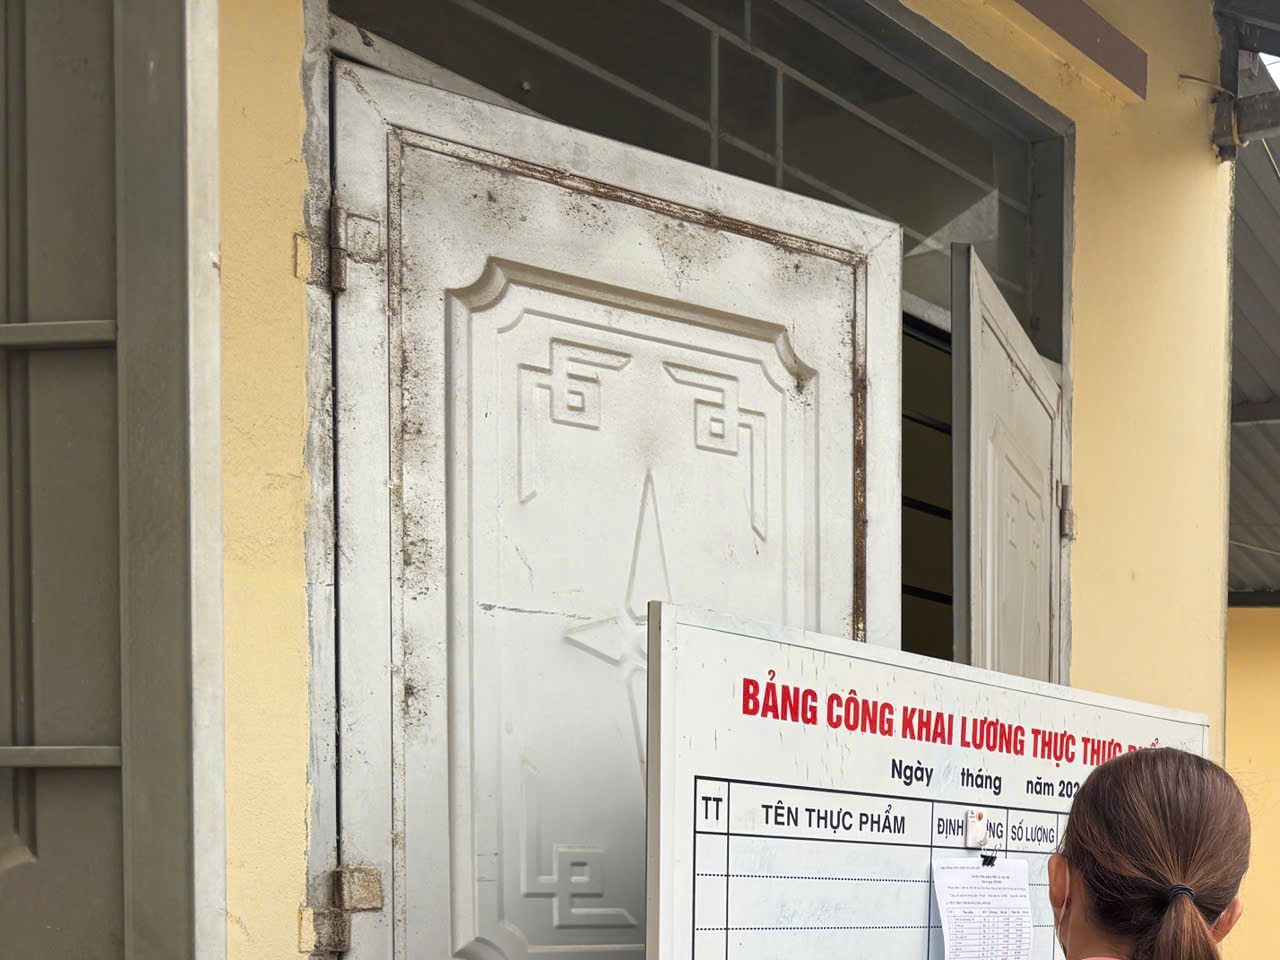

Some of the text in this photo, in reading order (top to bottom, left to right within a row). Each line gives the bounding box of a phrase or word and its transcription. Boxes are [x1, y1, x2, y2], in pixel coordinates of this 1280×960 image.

[742, 669, 818, 726] BẢNG
[826, 689, 894, 737] CÔNG
[901, 706, 954, 746] KHAI
[960, 716, 1026, 757] LƯƠNG
[1031, 728, 1076, 768] THỰC
[891, 758, 934, 787] Ngày
[960, 767, 1002, 796] tháng
[1026, 776, 1054, 797] năm
[701, 796, 723, 821] TT
[761, 800, 906, 834] TÊN THỰC PHẨM
[937, 817, 964, 839] ĐỊNH
[1011, 819, 1024, 842] SỐ
[1025, 824, 1055, 846] LƯỢNG
